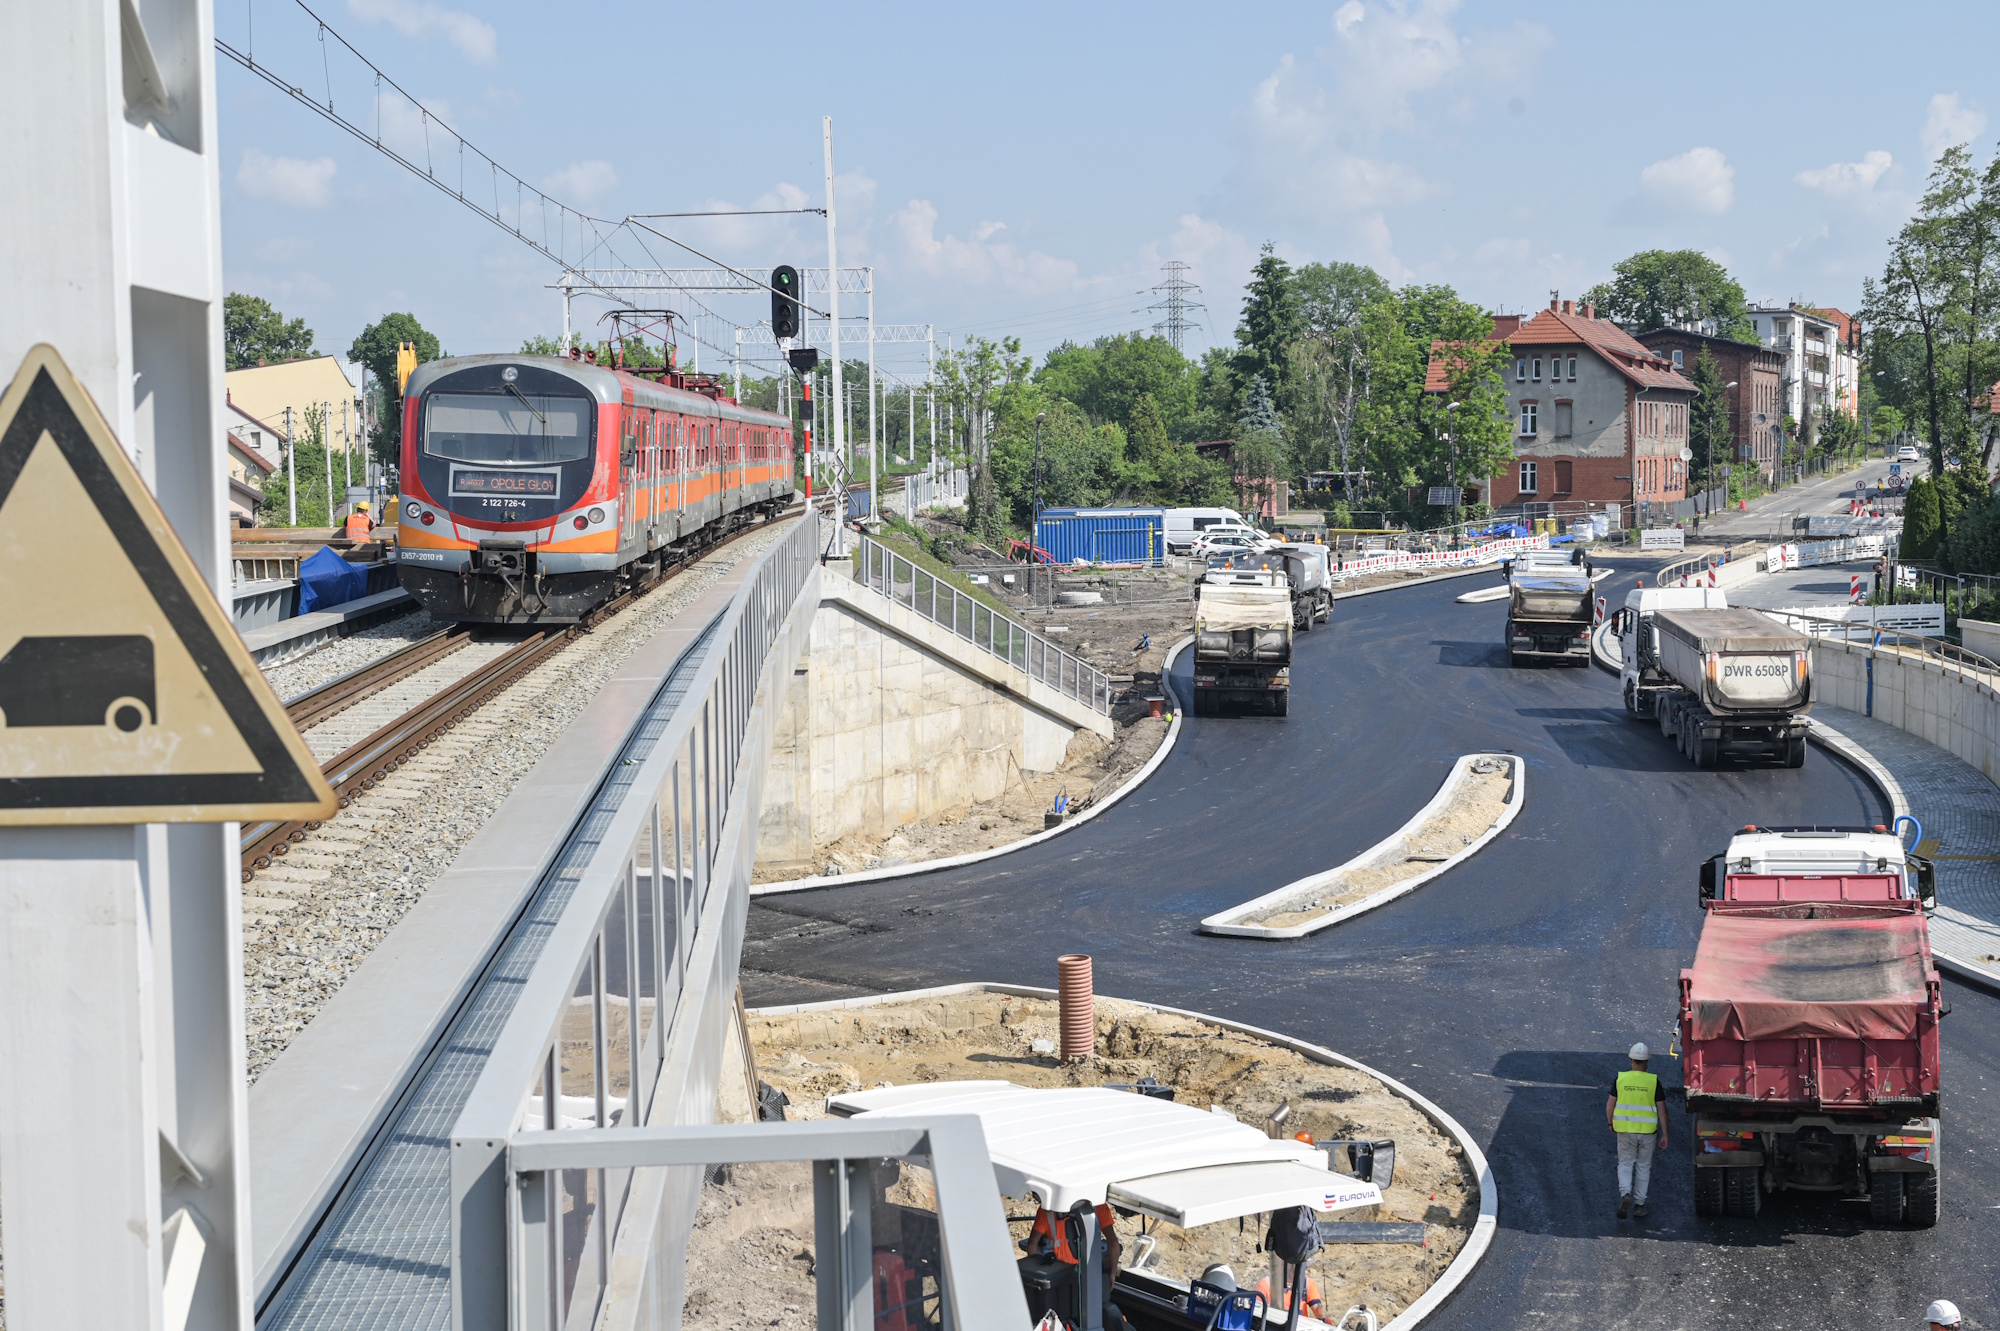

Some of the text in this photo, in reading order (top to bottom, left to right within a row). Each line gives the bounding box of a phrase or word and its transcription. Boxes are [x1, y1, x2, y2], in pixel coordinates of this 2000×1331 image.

[490, 478, 525, 490] OPOLE
[1890, 478, 1900, 486] 30
[482, 499, 526, 508] 2 122 726-4
[401, 551, 435, 561] EN57-2010
[1724, 664, 1789, 677] DWR 6508P
[1339, 1190, 1376, 1203] EUROVIA
